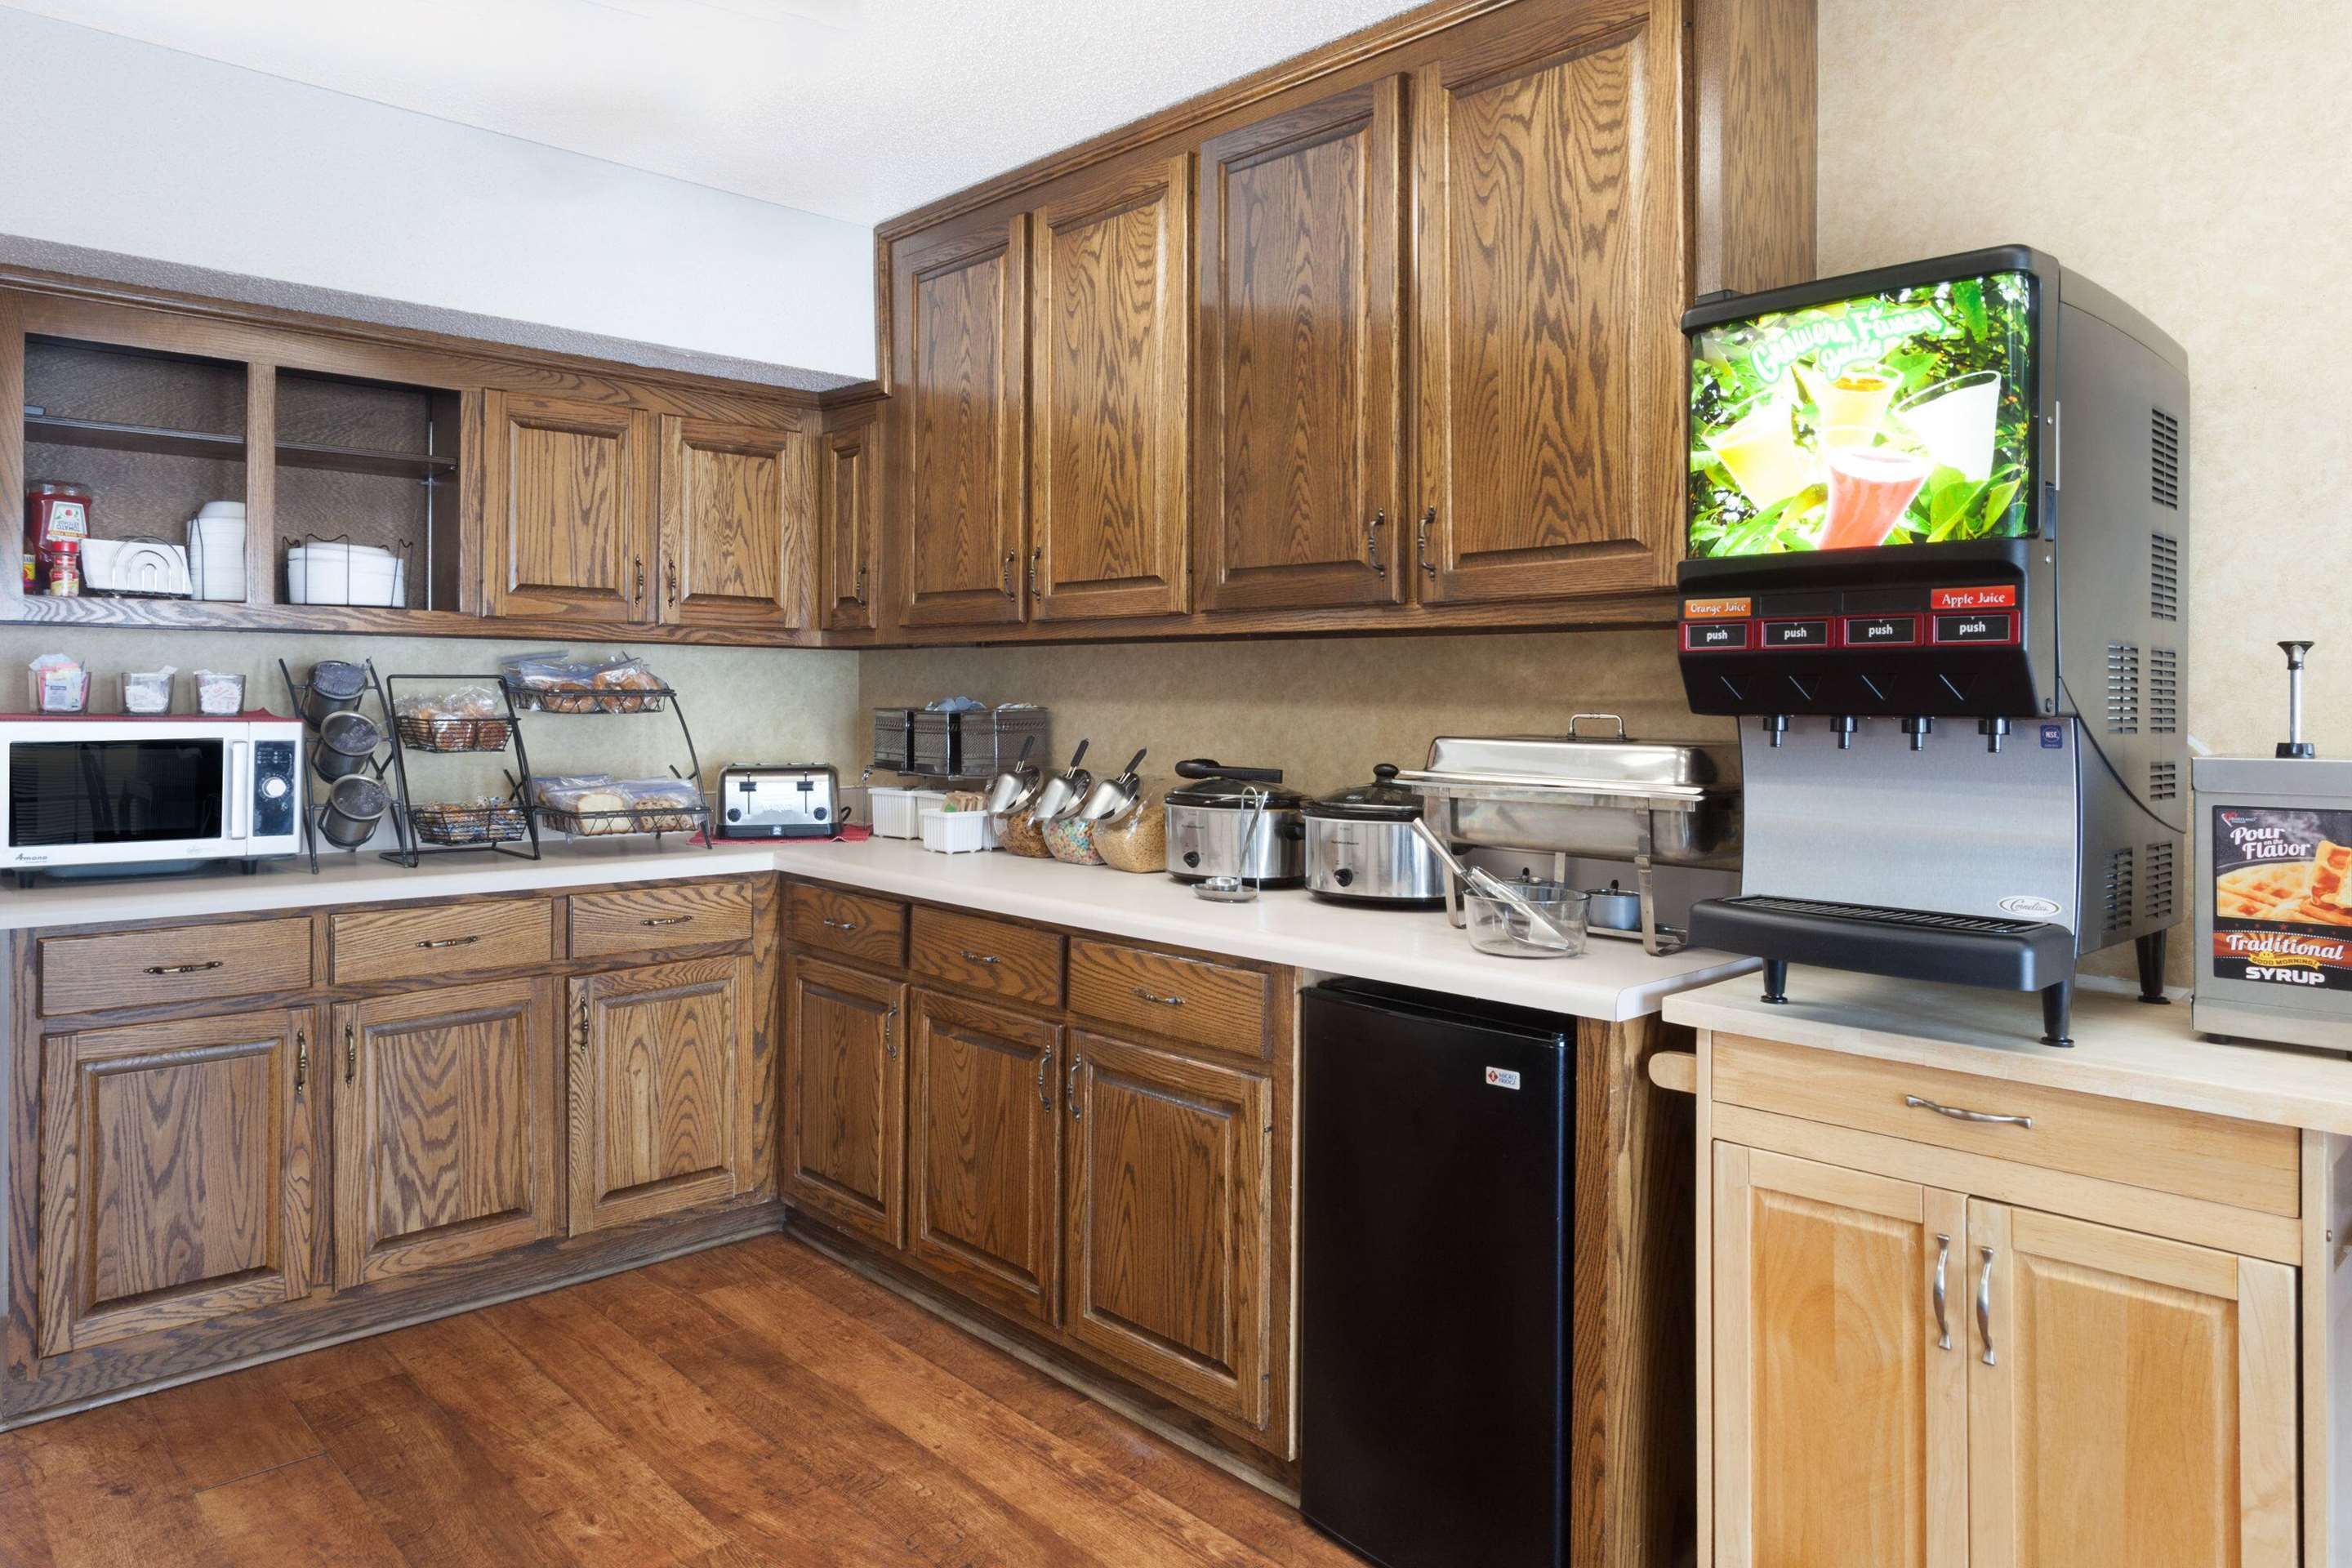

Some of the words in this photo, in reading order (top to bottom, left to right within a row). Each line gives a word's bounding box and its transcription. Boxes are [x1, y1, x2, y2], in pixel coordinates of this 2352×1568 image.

[1942, 594, 1973, 608] Apple
[1977, 593, 2005, 603] Juice
[1690, 604, 1721, 614] Orange
[1724, 603, 1746, 612] Juice
[1784, 627, 1807, 640] push
[1869, 624, 1893, 638] push
[1959, 621, 1986, 635] push
[1706, 630, 1728, 642] push
[2230, 826, 2286, 845] Pour
[2242, 842, 2311, 860] Flavor
[2226, 933, 2344, 960] Traditional
[2252, 956, 2274, 965] GOOD
[2246, 966, 2325, 985] SYRUP
